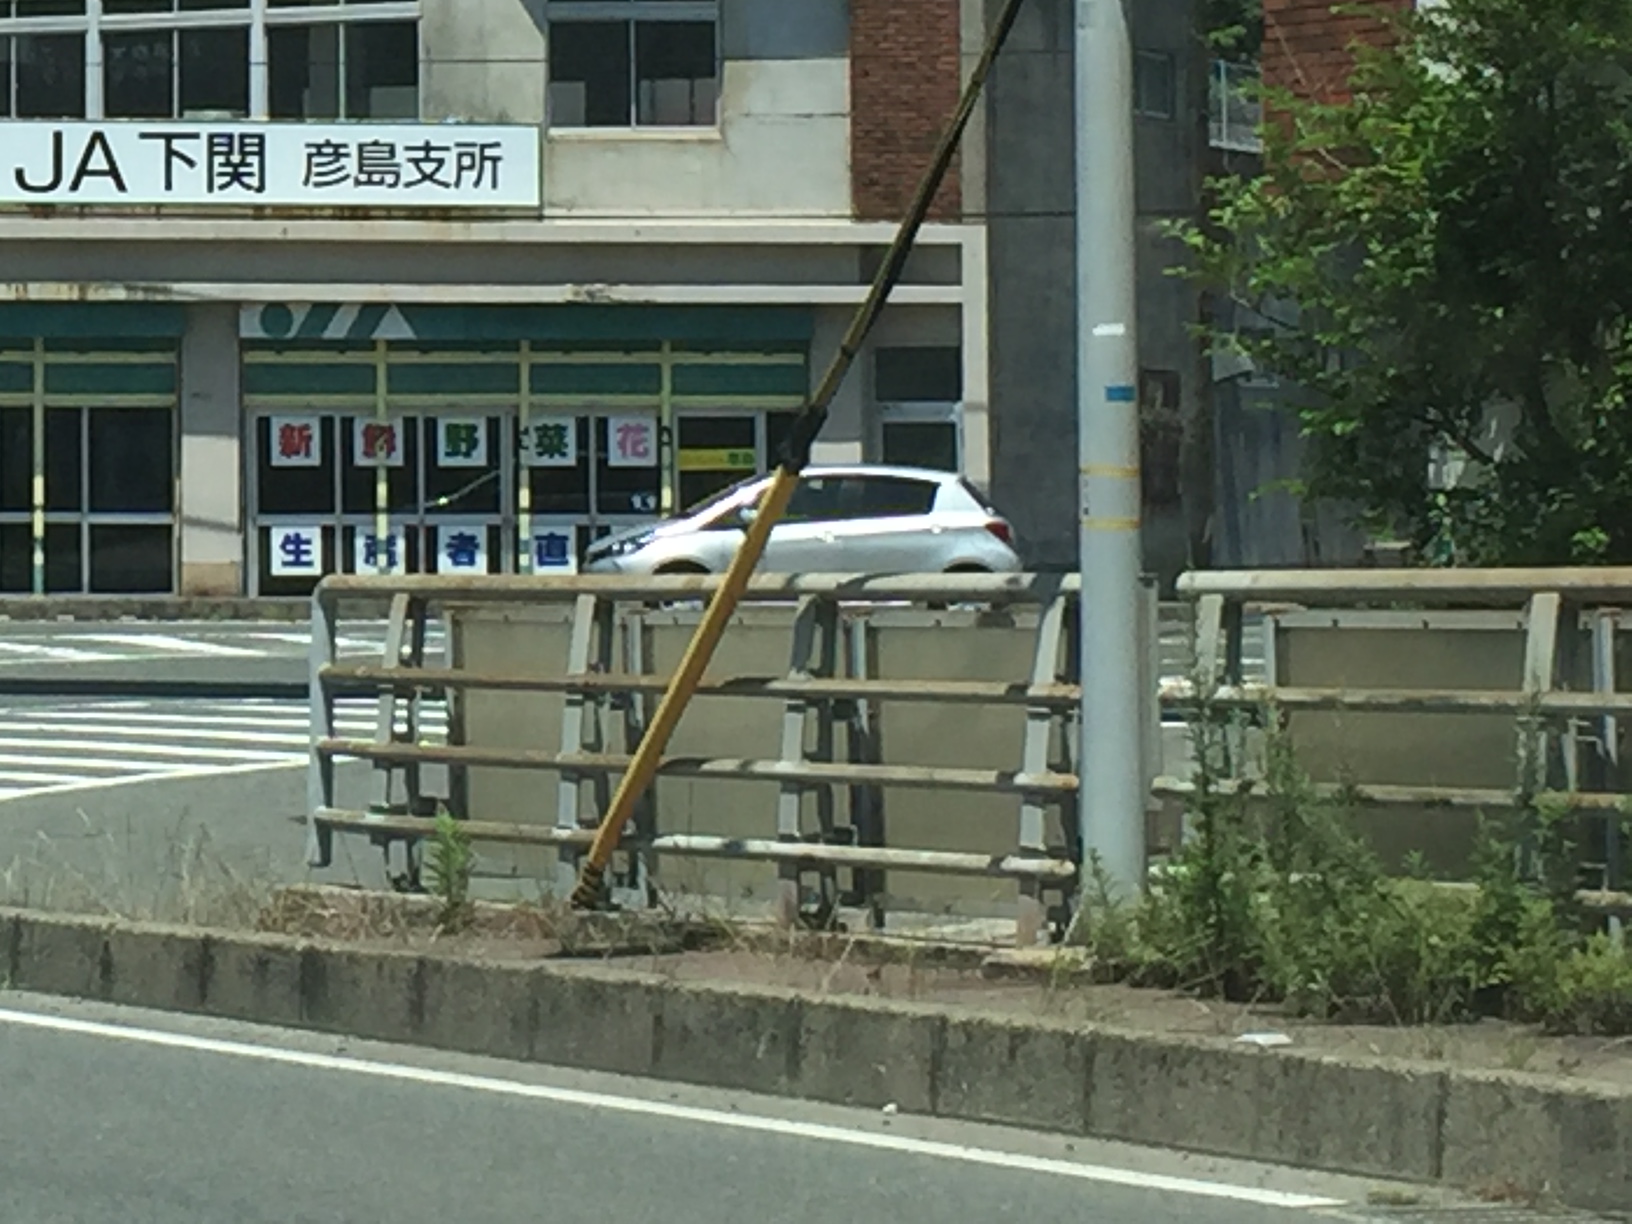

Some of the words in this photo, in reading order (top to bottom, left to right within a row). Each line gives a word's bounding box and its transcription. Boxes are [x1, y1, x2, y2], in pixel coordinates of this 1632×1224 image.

[14, 130, 266, 195] JA下関
[303, 138, 503, 192] 彦島支所
